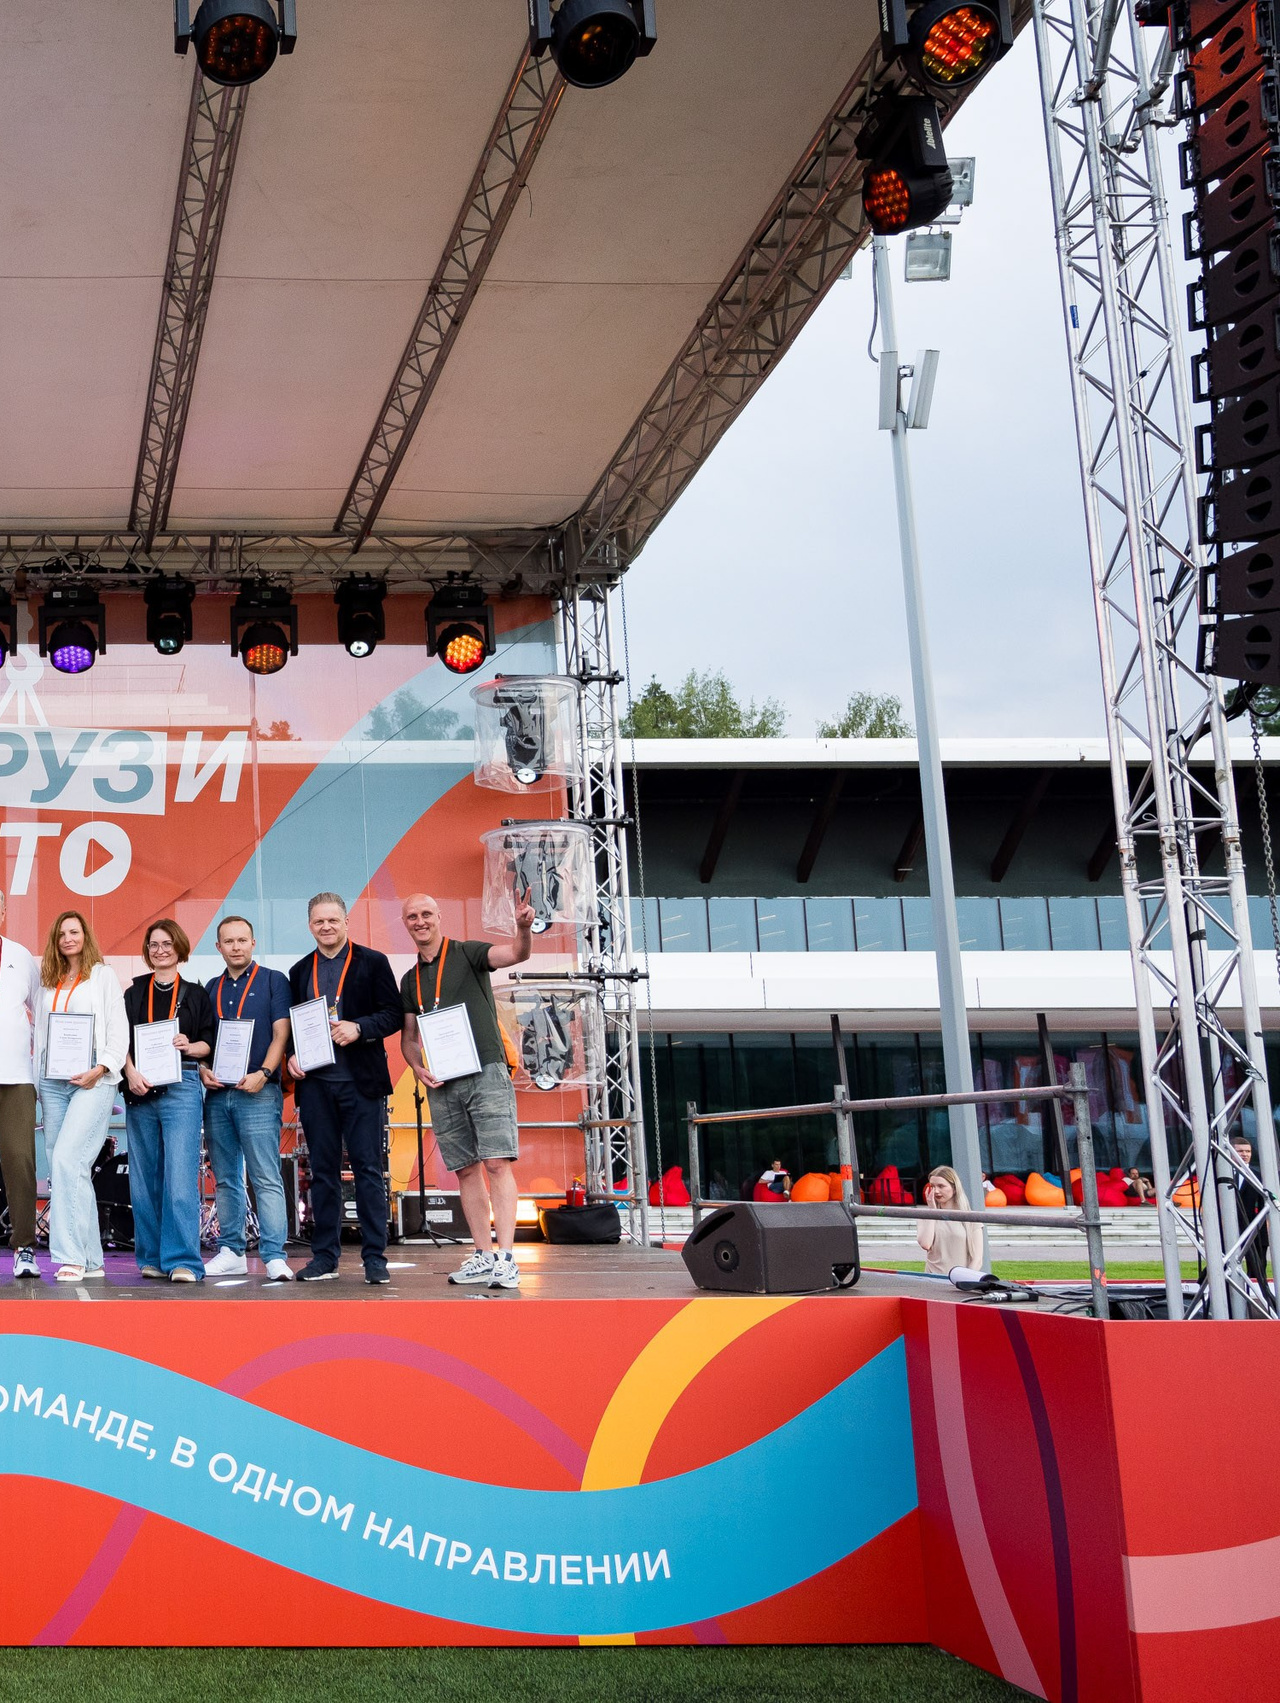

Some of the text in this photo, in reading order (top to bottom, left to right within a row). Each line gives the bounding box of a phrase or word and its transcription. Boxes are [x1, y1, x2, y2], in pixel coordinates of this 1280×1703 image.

[170, 1435, 198, 1468] В
[208, 1452, 355, 1532] ОДНОМ
[362, 1511, 671, 1585] НАПРАВЛЕНИИ
